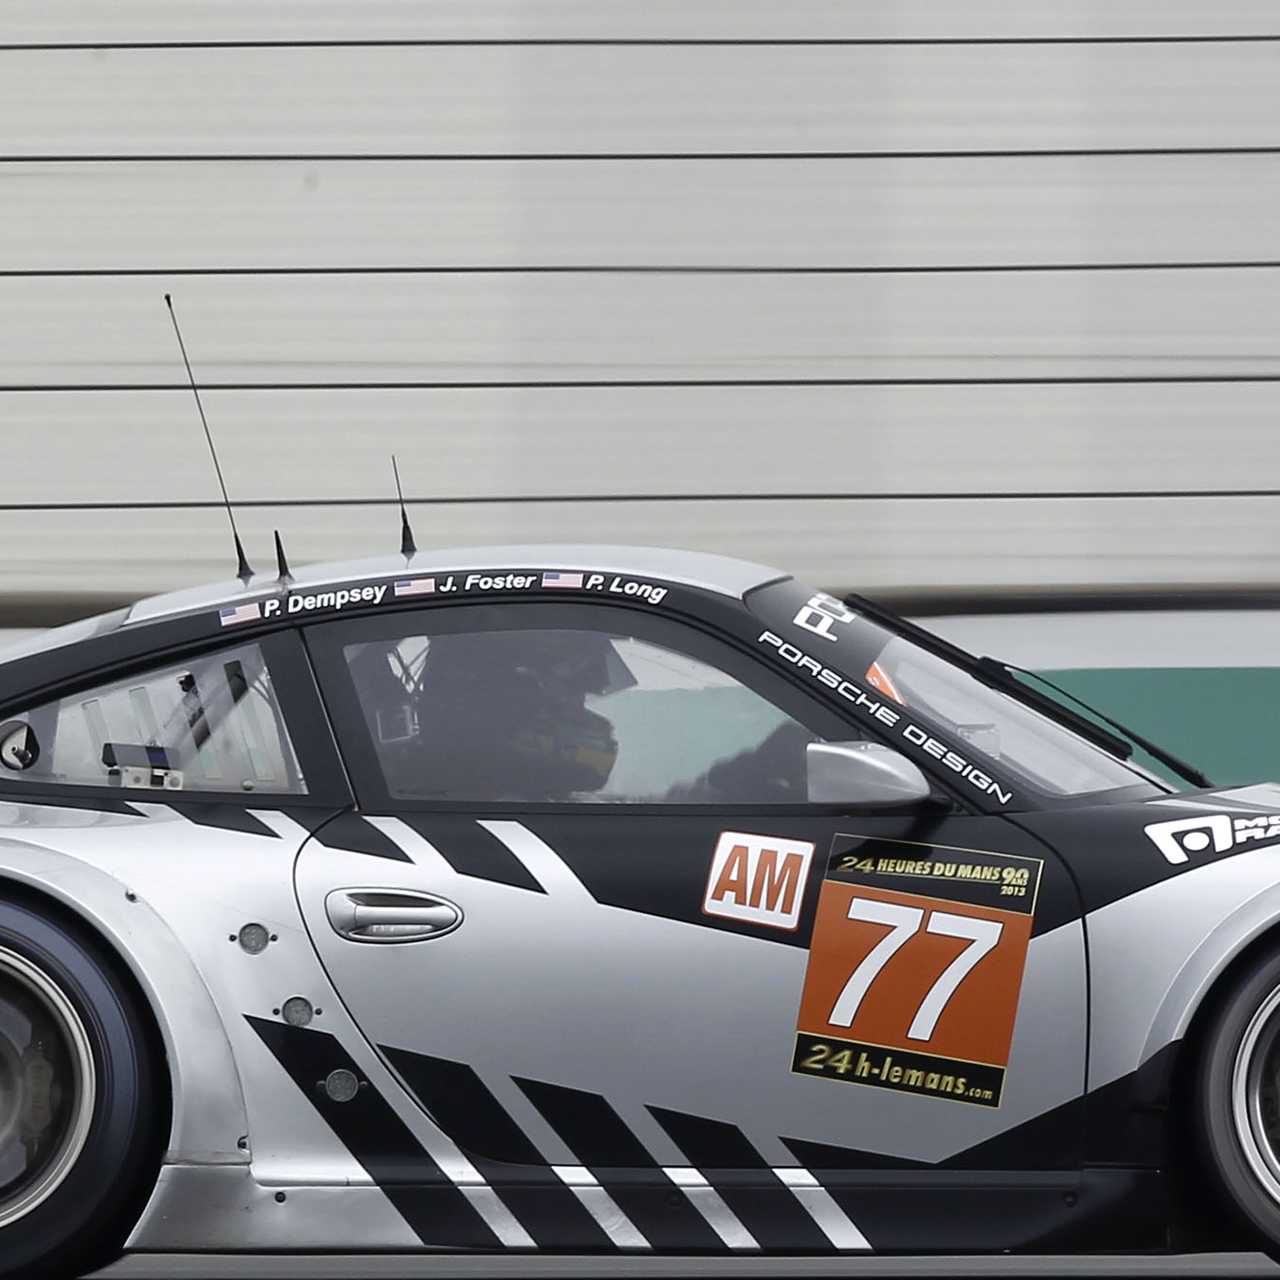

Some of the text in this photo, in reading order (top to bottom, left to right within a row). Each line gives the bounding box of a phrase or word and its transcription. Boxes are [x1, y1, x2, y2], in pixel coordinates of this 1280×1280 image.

[439, 572, 536, 593] J. Foster
[585, 574, 668, 604] P. Long
[264, 583, 387, 617] P. Dempsey
[758, 631, 1014, 804] PORSCHE DESIGN
[710, 844, 806, 916] AM
[837, 856, 874, 873] 24
[877, 858, 932, 875] HEURES
[933, 863, 957, 877] DU
[958, 865, 1001, 881] MANS
[1000, 886, 1027, 896] 2013
[827, 897, 1005, 1042] 77
